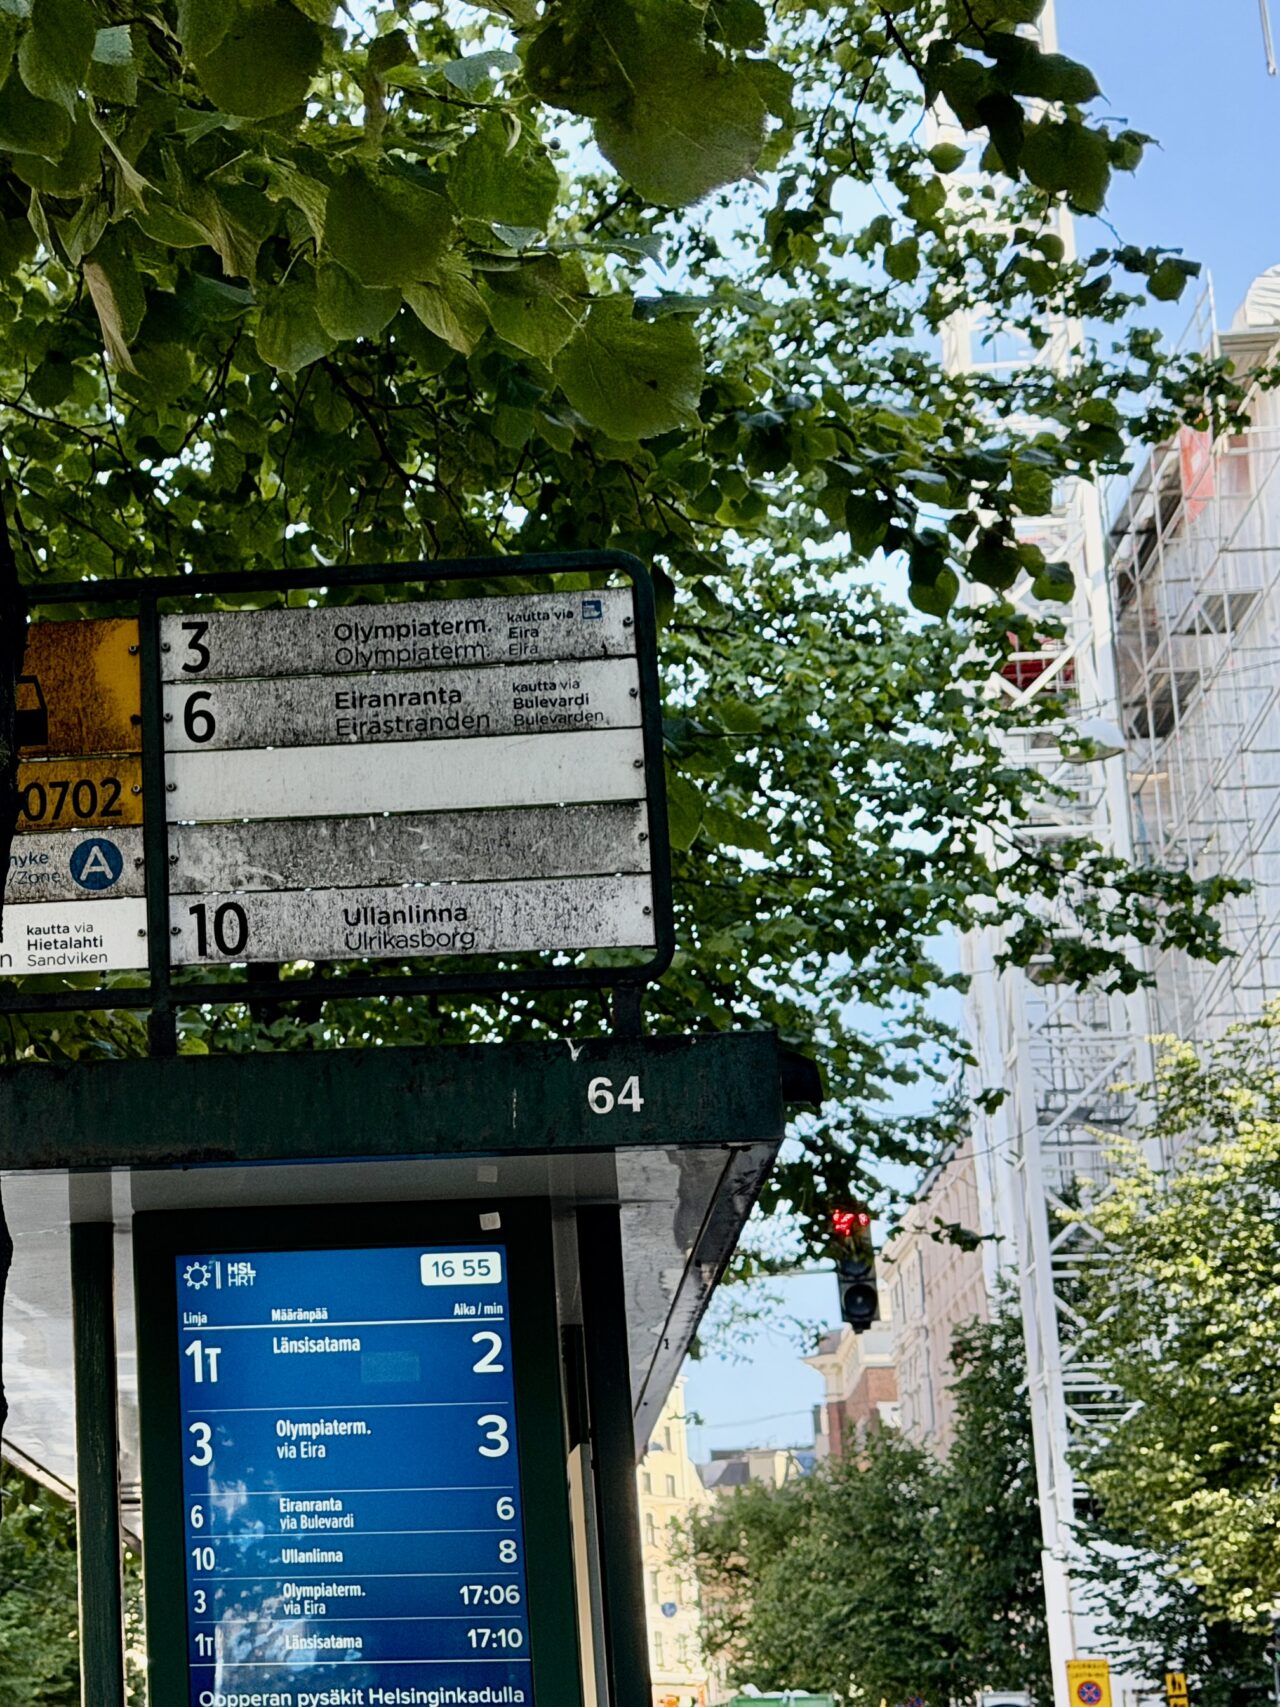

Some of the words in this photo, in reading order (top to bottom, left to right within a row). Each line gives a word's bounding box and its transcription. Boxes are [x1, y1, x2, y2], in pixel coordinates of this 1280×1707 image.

[507, 611, 550, 623] kautta
[553, 609, 574, 620] via
[334, 618, 492, 644] Olympiaterm.
[508, 627, 539, 639] Eira
[181, 621, 210, 673] 3
[335, 642, 491, 668] Olympiaterm.
[508, 642, 538, 656] Eira
[512, 681, 557, 693] kautta
[559, 679, 580, 691] via
[335, 686, 462, 710] Eiranranta
[513, 692, 590, 710] Bulevardi
[183, 690, 217, 743] 6
[513, 710, 604, 727] Bulevarden
[79, 845, 114, 881] A
[343, 904, 468, 927] Ullanlinna
[26, 924, 70, 936] kautta
[74, 922, 94, 934] via
[189, 901, 249, 957] 10
[345, 928, 475, 951] Ulrikasborg
[26, 935, 103, 950] Hietalahti
[27, 951, 108, 967] Sandviken
[587, 1075, 645, 1114] 64
[227, 1262, 256, 1274] HSL
[228, 1273, 256, 1287] HRT
[183, 1311, 208, 1326] Linja
[271, 1307, 328, 1323] Määränpää
[453, 1302, 477, 1317] Aika
[478, 1302, 483, 1317] /
[484, 1301, 504, 1316] min
[272, 1335, 361, 1355] Länsisatama
[471, 1331, 505, 1374] 2
[184, 1340, 222, 1384] 1T
[276, 1418, 372, 1440] Olympiaterm.
[476, 1414, 510, 1459] 3
[189, 1421, 213, 1468] 3
[277, 1444, 298, 1460] via
[300, 1442, 327, 1459] Eira
[279, 1497, 343, 1514] Eiranranta
[496, 1496, 516, 1521] 6
[190, 1504, 204, 1529] 6
[279, 1514, 298, 1531] via
[300, 1513, 355, 1530] Bulevardi
[192, 1547, 216, 1571] 10
[281, 1548, 344, 1564] Ullanlinna
[499, 1539, 518, 1564] 8
[283, 1582, 367, 1600] Olympiaterm.
[459, 1584, 521, 1606] 17:06
[194, 1590, 207, 1614] 3
[283, 1601, 301, 1615] via
[303, 1600, 327, 1615] Eira
[285, 1633, 363, 1651] Länsisatama
[467, 1627, 523, 1649] 17:10
[199, 1690, 292, 1707] Oopperan
[297, 1688, 364, 1707] pysäkit
[368, 1686, 525, 1707] Helsinginkadulla
